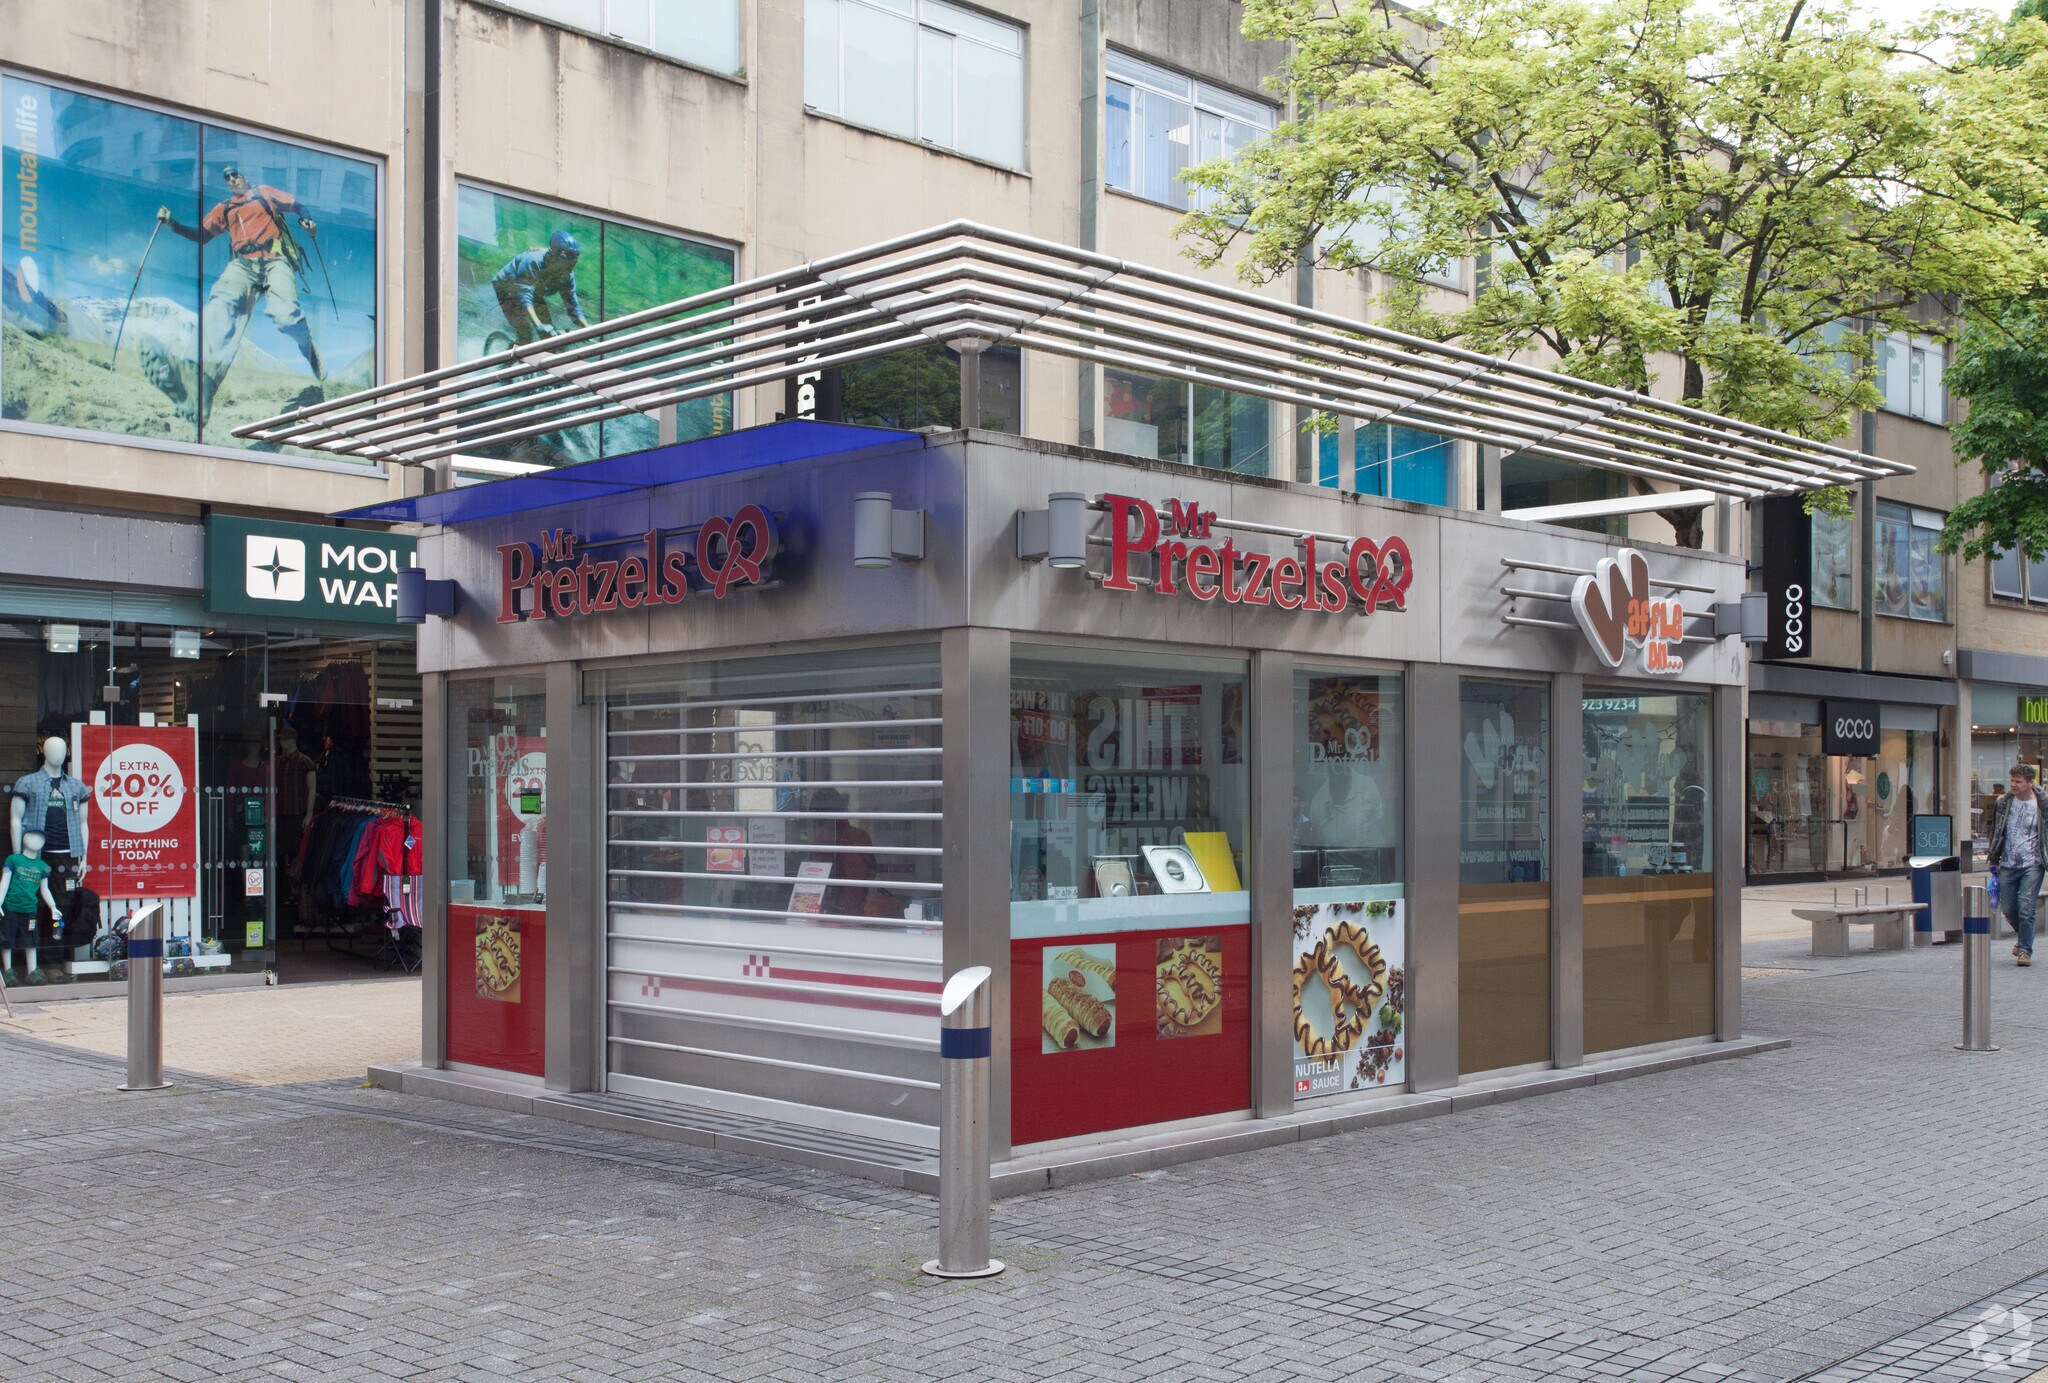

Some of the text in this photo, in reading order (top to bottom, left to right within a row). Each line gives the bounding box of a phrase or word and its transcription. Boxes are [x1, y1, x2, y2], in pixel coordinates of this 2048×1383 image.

[16, 95, 38, 251] mountainlife
[1170, 498, 1217, 538] Mr
[541, 528, 577, 563] Mr
[1102, 493, 1347, 614] Pretzels
[496, 528, 687, 623] Pretzels
[1785, 584, 1803, 652] ecco
[1605, 698, 1636, 710] 9234
[1835, 718, 1873, 740] ecco
[119, 761, 159, 770] EXTRA
[103, 773, 176, 798] 20%
[120, 801, 159, 815] OFF
[101, 838, 178, 849] EVERYTHING
[1918, 831, 1948, 848] 30%
[119, 850, 161, 860] TODAY
[1295, 1059, 1340, 1077] NUTELLA
[1312, 1076, 1340, 1090] SAUCE
